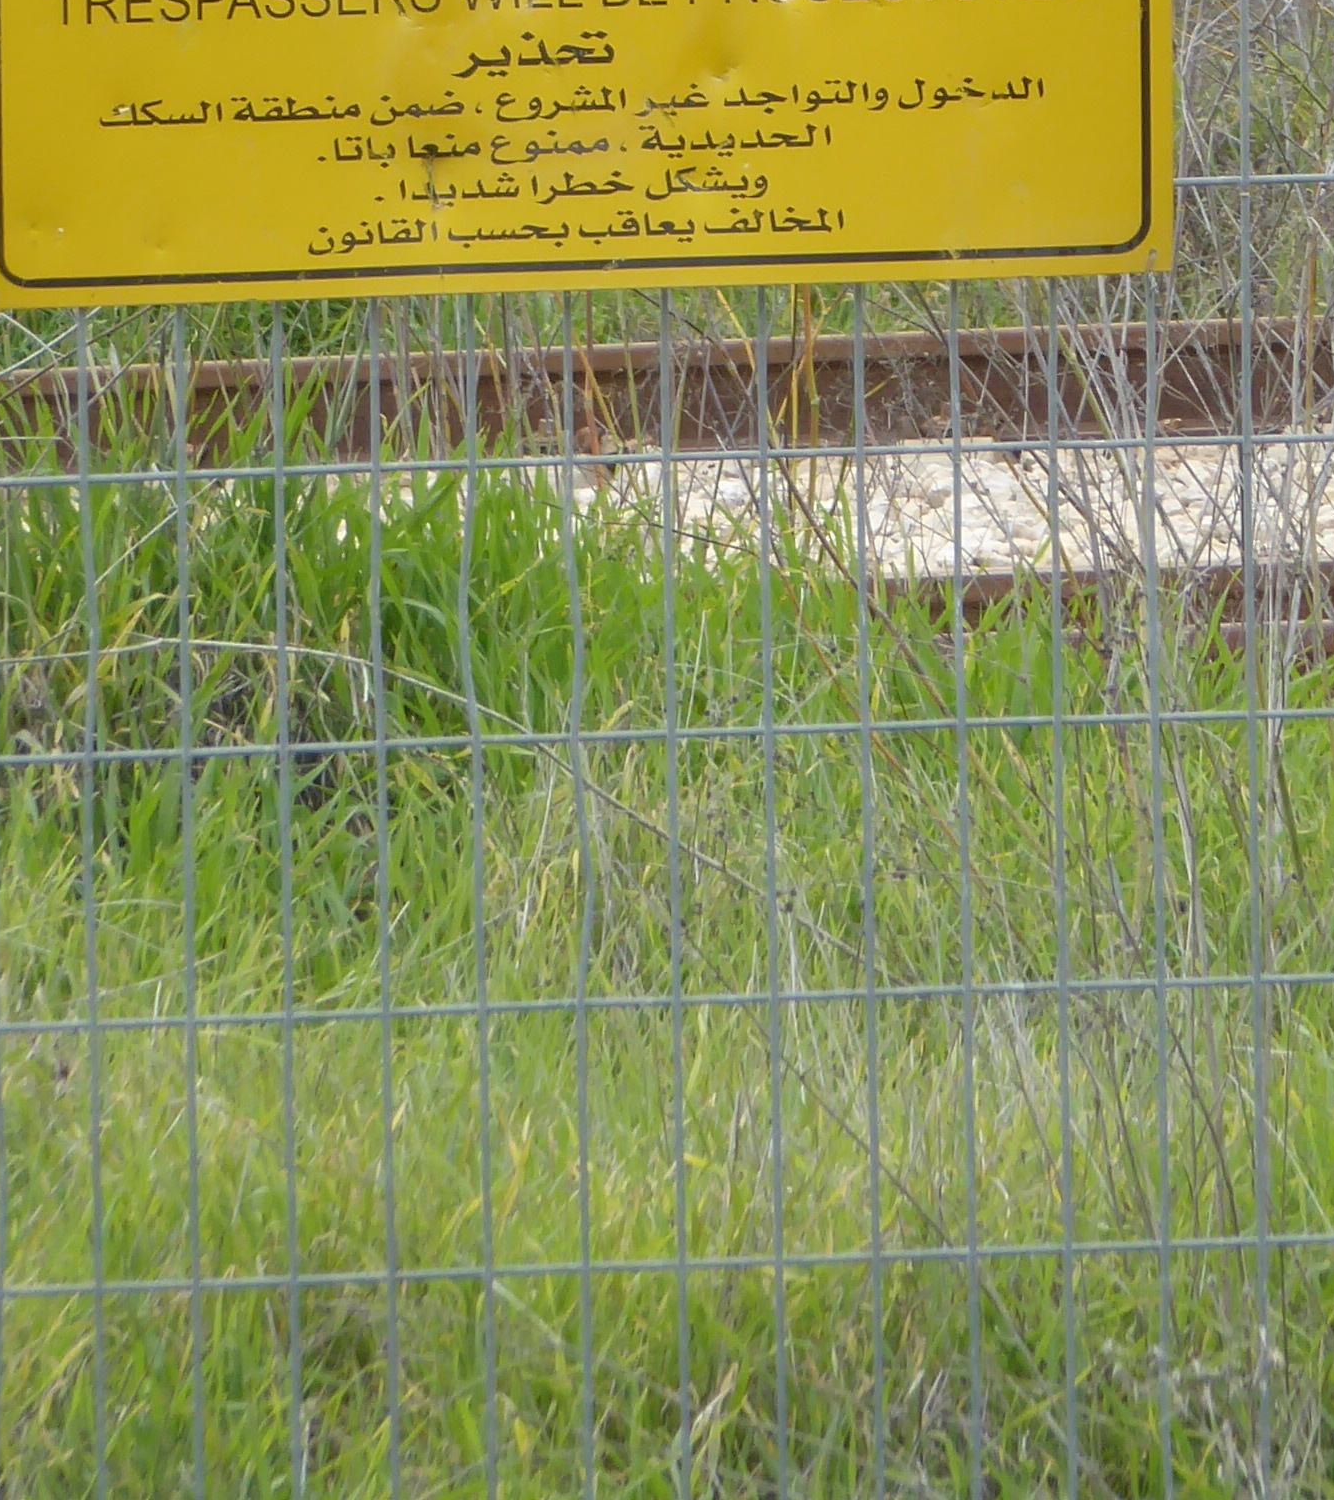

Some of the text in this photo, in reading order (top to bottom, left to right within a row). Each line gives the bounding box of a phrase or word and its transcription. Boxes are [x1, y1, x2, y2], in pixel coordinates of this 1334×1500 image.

[450, 29, 615, 78] تحذير
[233, 94, 361, 125] منطقة
[369, 89, 465, 127] ضمن
[635, 83, 710, 117] غير
[722, 79, 890, 115] والتواجد
[897, 74, 1045, 110] الدخول
[99, 99, 223, 128] السكك
[407, 132, 481, 162] منعا
[490, 130, 610, 165] ممنوع
[532, 169, 635, 205] خطرا
[645, 165, 769, 201] ويشكل
[307, 206, 846, 256] المخالف يعاقب بحسب القانون
